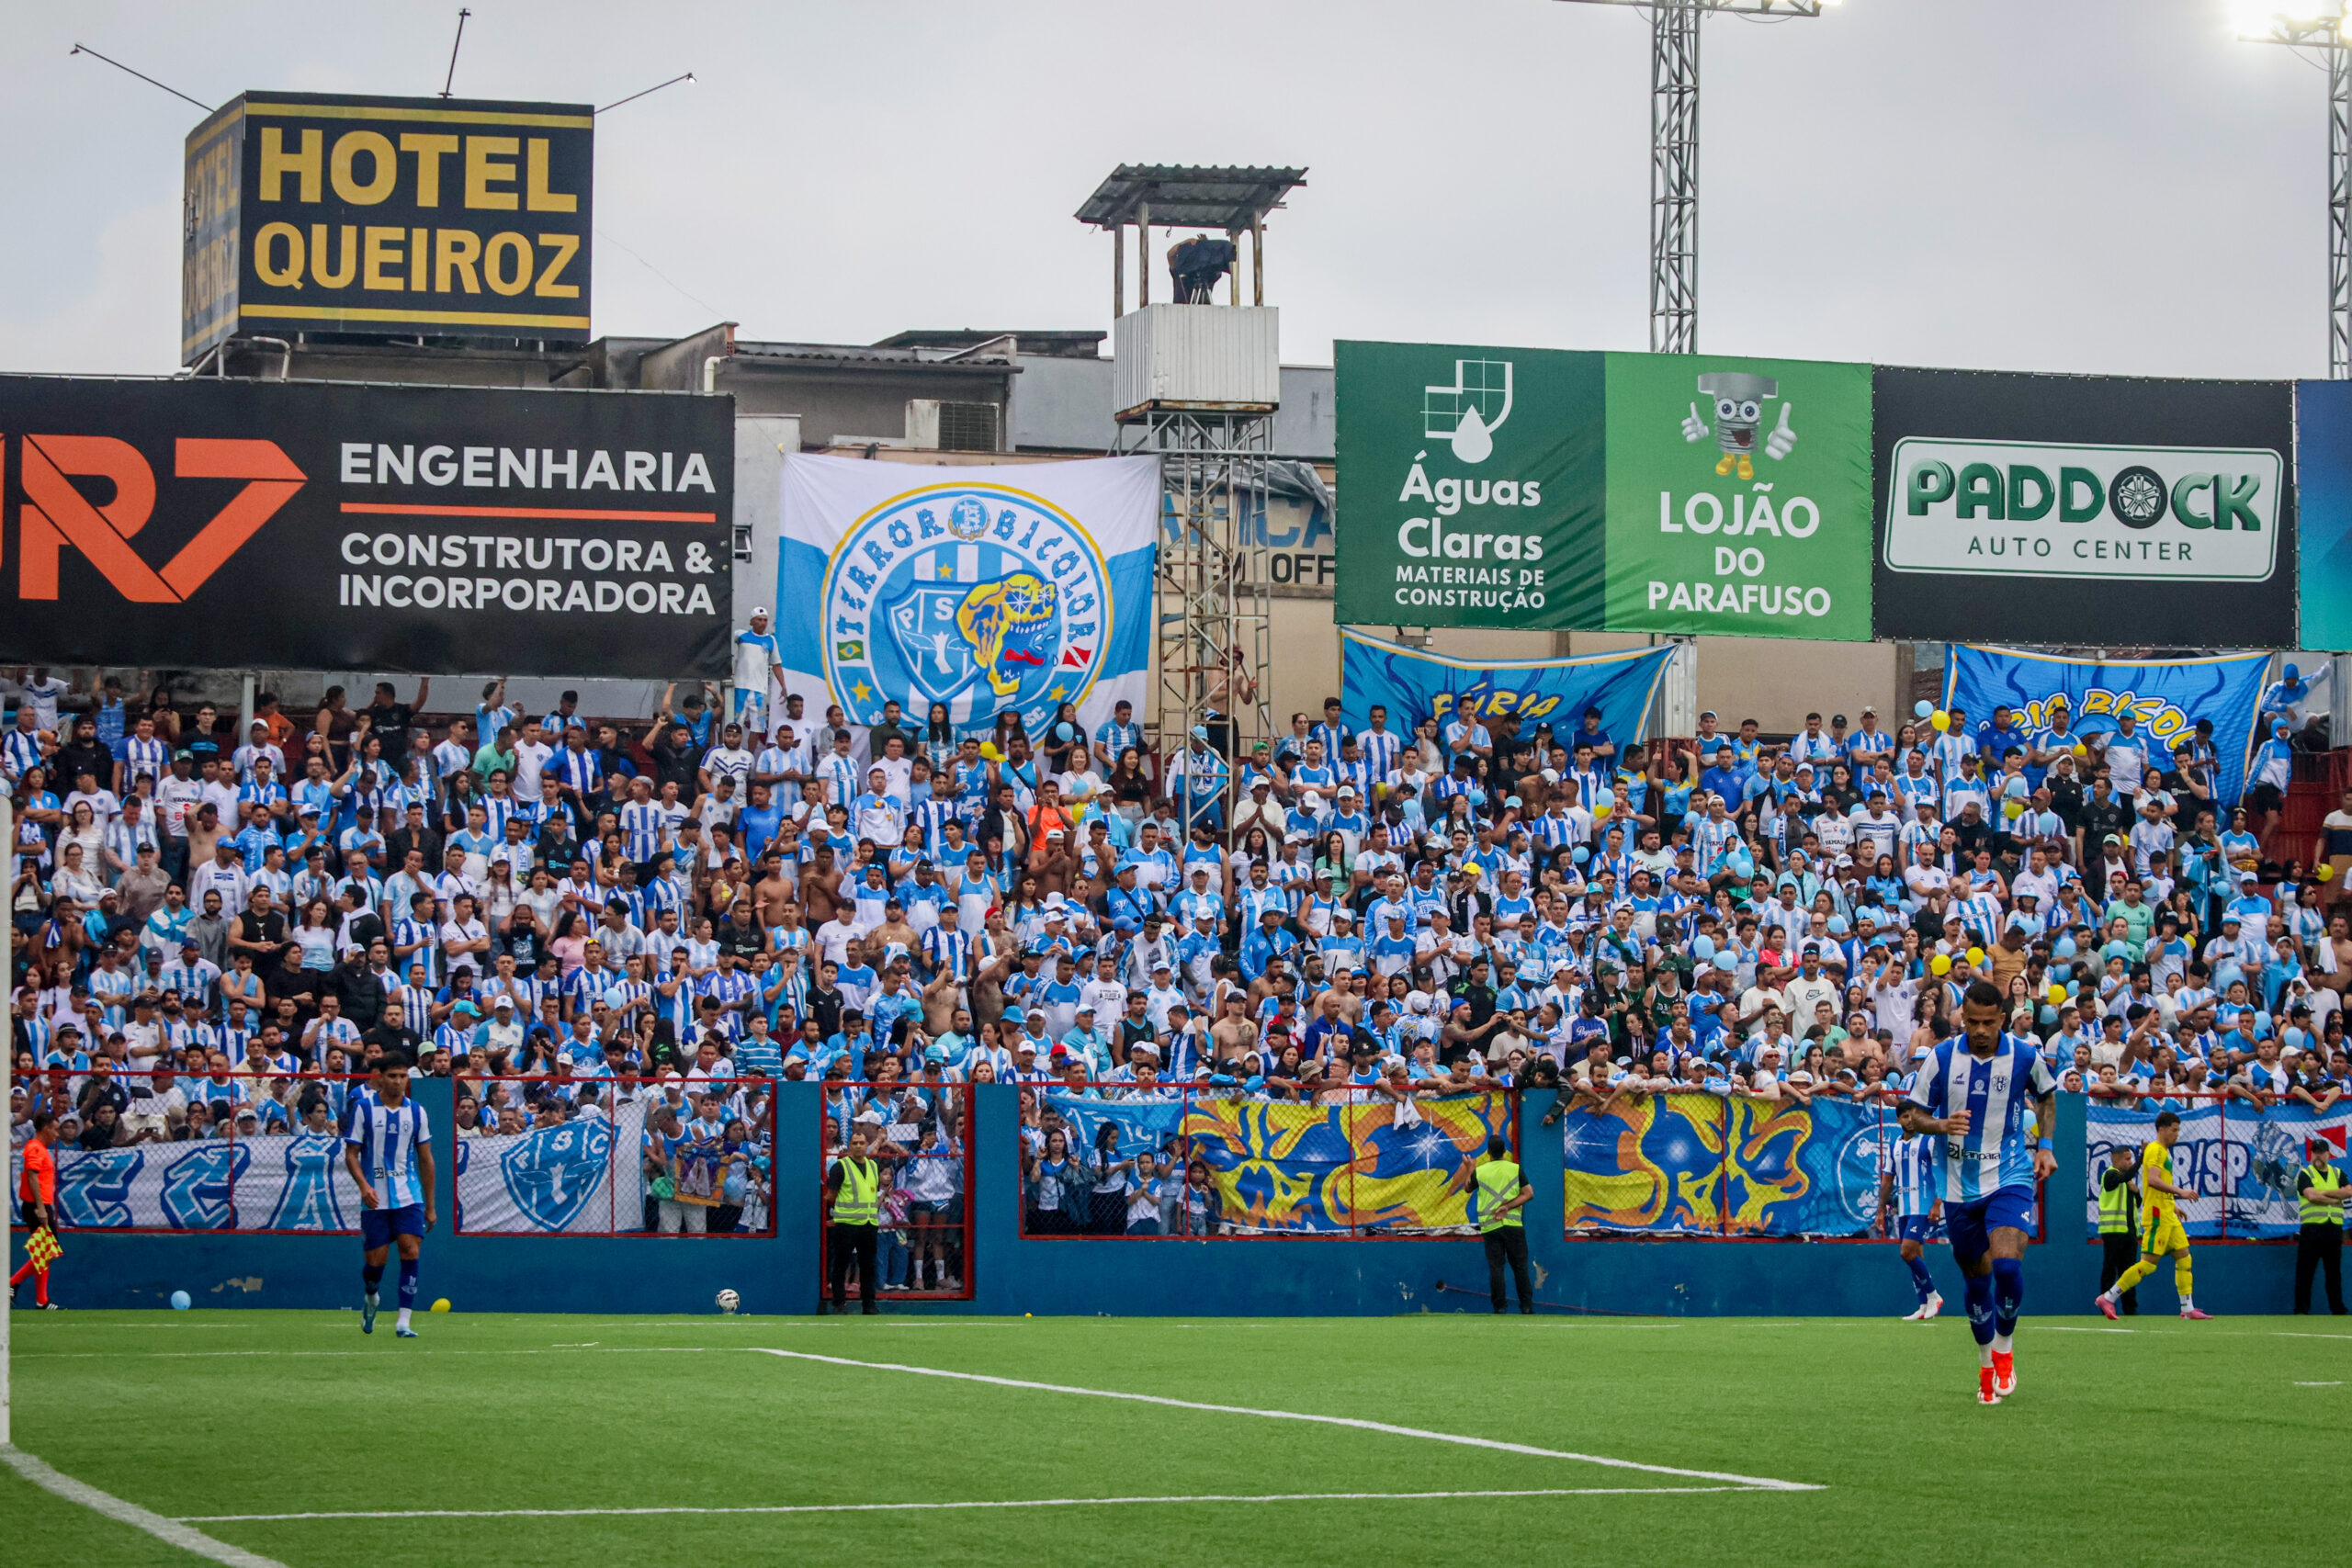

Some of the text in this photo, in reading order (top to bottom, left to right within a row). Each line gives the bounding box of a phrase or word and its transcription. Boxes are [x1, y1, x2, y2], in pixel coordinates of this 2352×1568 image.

[259, 127, 577, 213] HOTEL
[254, 221, 580, 299] QUEIROZ
[341, 443, 717, 493] ENGENHARIA
[1398, 451, 1542, 516] Águas
[0, 433, 309, 604] R7
[1660, 483, 1820, 538] LOJÃO
[341, 532, 715, 574] CONSTRUTORA &
[1396, 517, 1544, 560] Claras
[1968, 536, 2193, 561] AUTO CENTER
[992, 509, 1097, 643] BICOLOR
[1396, 565, 1544, 586] MATERIAIS DE
[1714, 547, 1765, 577] DO
[340, 574, 717, 615] INCORPORADORA
[1395, 586, 1545, 613] CONSTRUÇÃO
[1647, 581, 1831, 616] PARAFUSO
